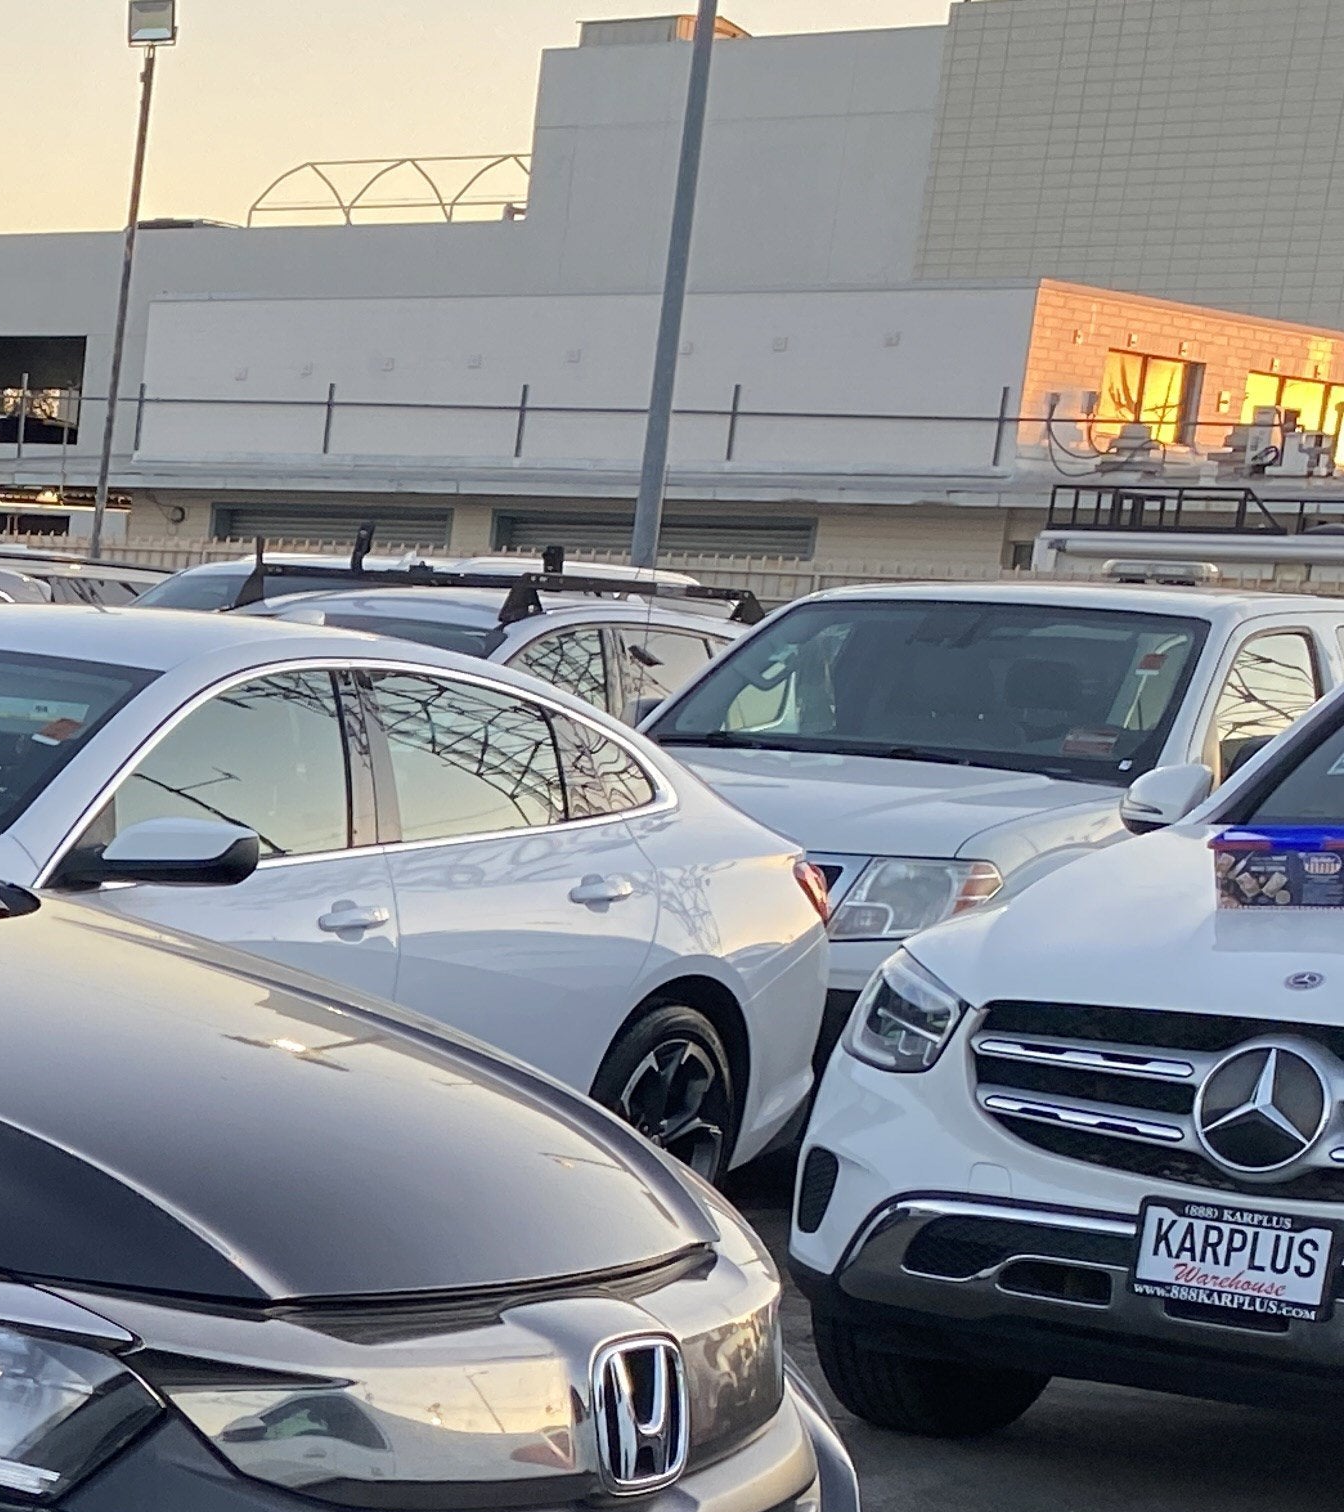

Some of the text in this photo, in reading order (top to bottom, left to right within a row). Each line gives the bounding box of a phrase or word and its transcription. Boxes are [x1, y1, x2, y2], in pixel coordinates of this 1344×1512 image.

[1184, 1204, 1292, 1230] (888) KARPLUS
[1152, 1217, 1320, 1278] KARPLUS
[1173, 1263, 1287, 1297] Warehouse
